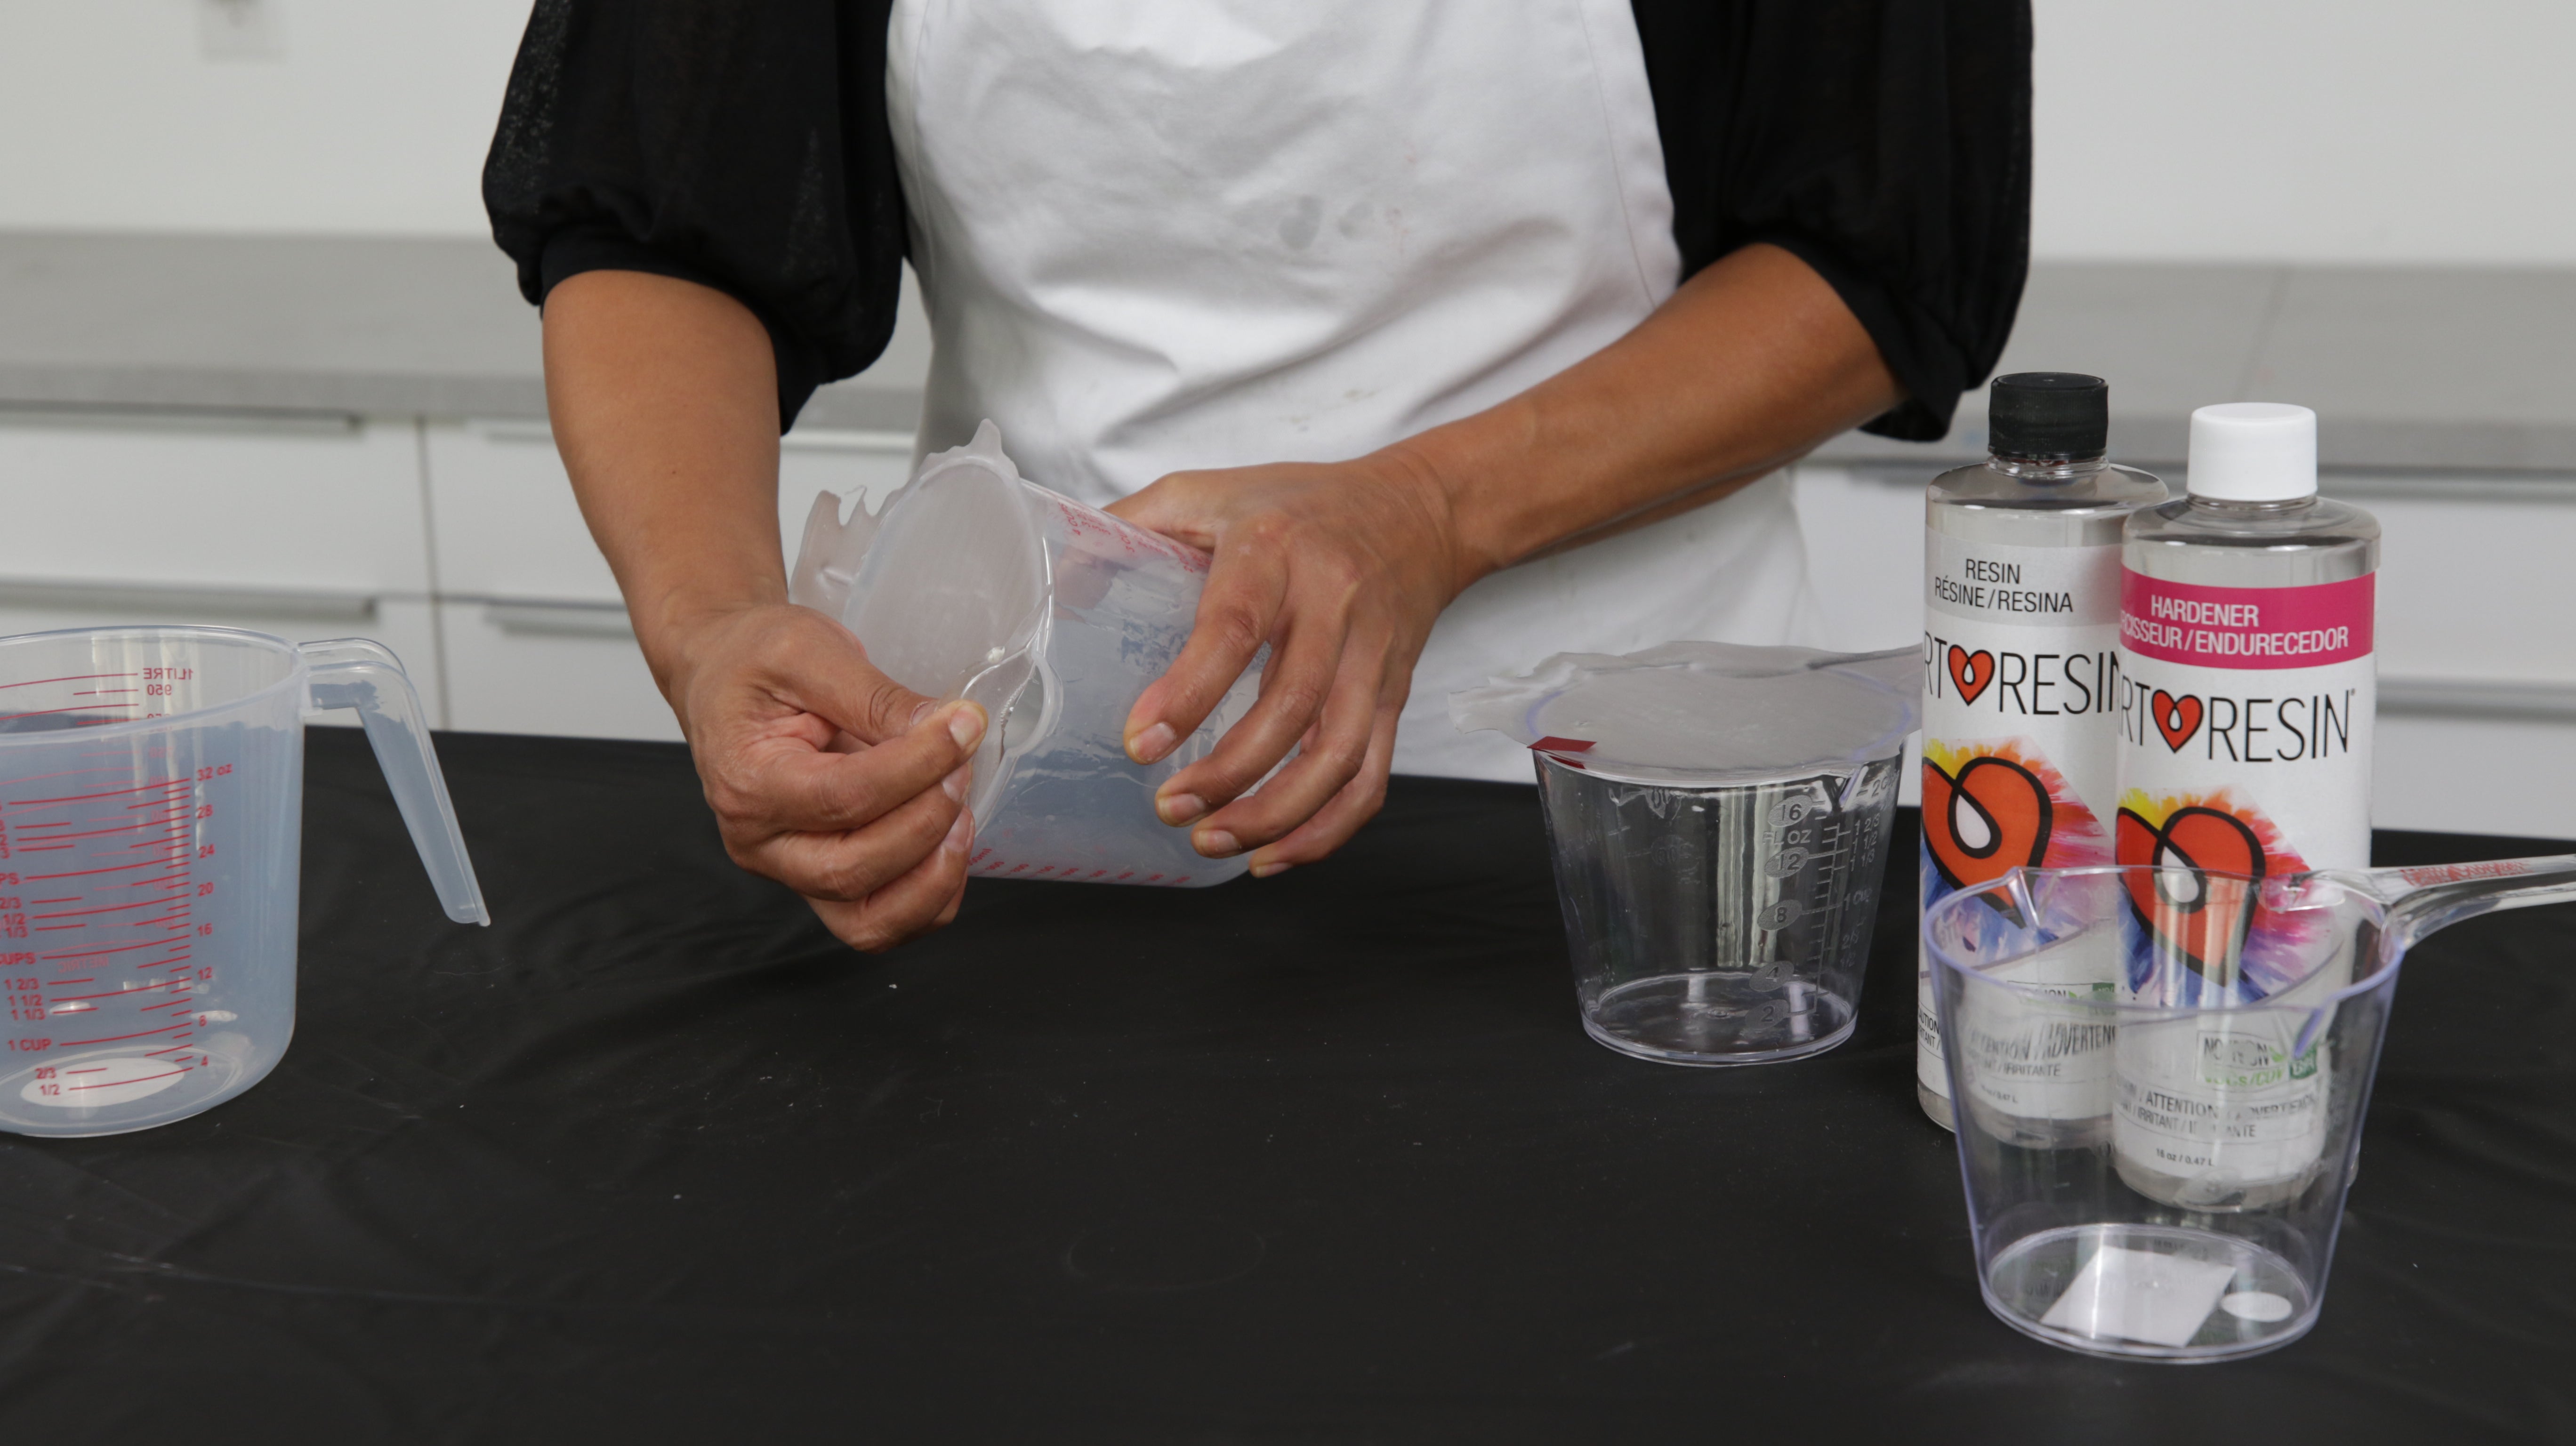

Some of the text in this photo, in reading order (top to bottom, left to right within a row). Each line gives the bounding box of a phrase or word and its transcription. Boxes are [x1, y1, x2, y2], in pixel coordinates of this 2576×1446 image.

[1965, 558, 2021, 584] RESIN
[2151, 594, 2260, 627] HARDENER
[196, 763, 233, 782] 32 oz
[196, 804, 213, 819] 28
[1780, 803, 1802, 821] 16
[1763, 829, 1812, 845] FL OZ
[198, 844, 215, 859] 24
[1774, 852, 1800, 871] 12
[197, 881, 214, 897] 20
[1774, 906, 1788, 924] 8
[197, 923, 213, 937] 16
[197, 966, 213, 980] 12
[4, 977, 40, 991] 1 2/3
[8, 994, 43, 1007] 1 1/2
[11, 1008, 46, 1021] 1 1/3
[198, 1014, 207, 1027] 8
[8, 1038, 52, 1051] 1 CUP
[200, 1055, 209, 1067] 4
[35, 1067, 56, 1079] 2/3
[40, 1084, 61, 1096] 1/2
